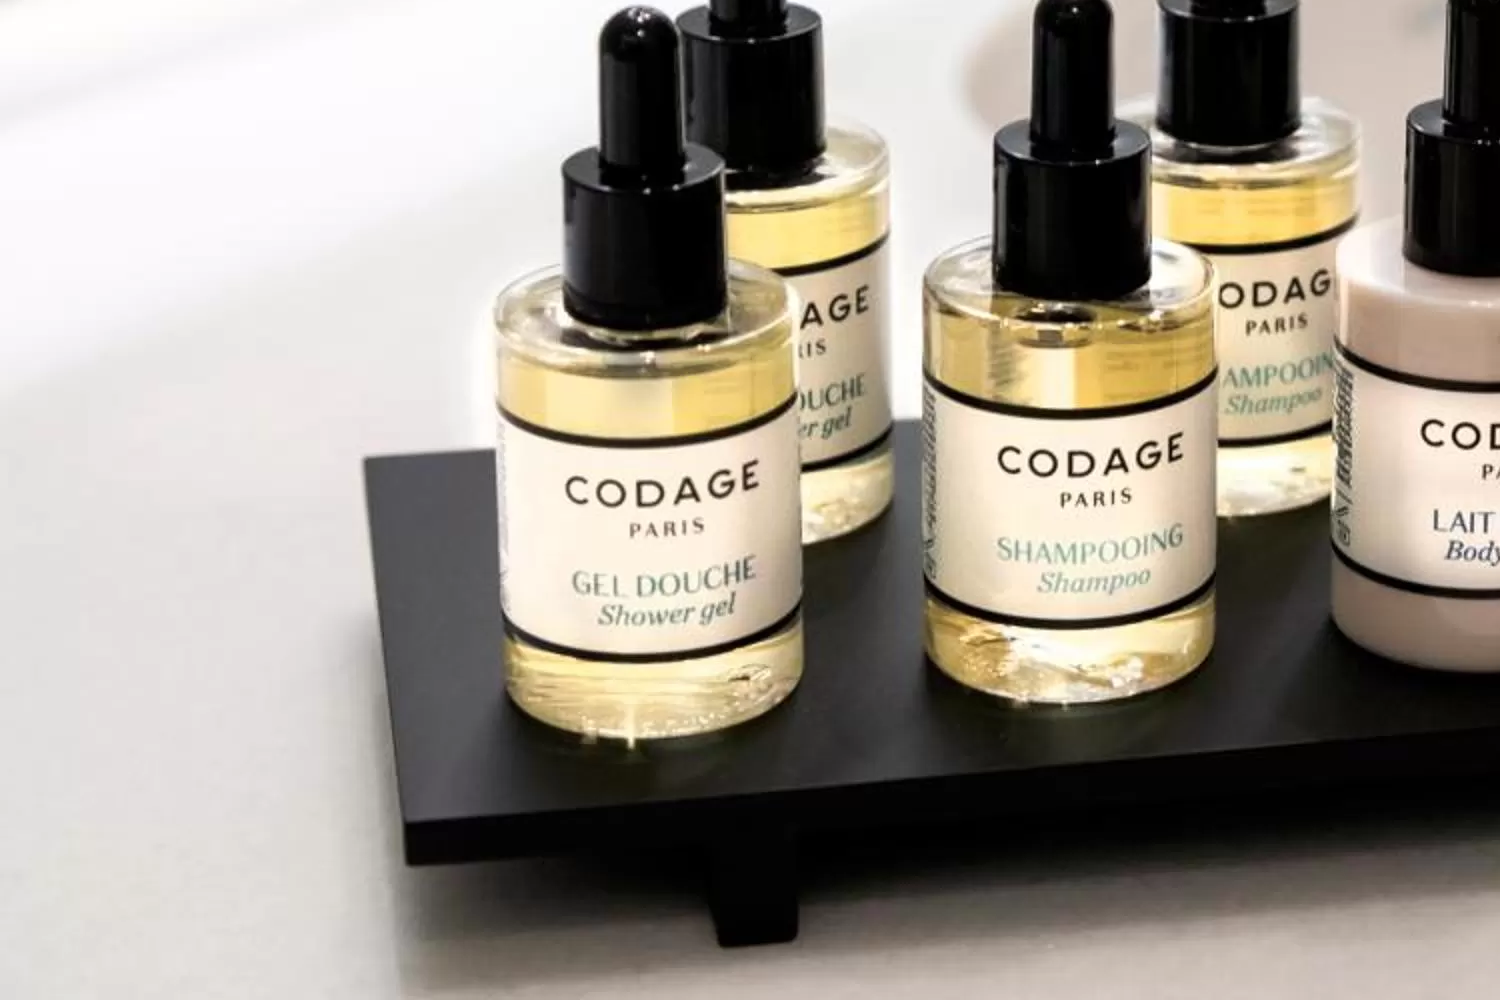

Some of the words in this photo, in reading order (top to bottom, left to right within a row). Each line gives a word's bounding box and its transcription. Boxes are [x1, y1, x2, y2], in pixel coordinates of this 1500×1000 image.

[1219, 268, 1331, 309] ODAG
[800, 284, 869, 330] AGE
[1246, 312, 1308, 336] PARIS
[1222, 351, 1333, 388] AMPOOIN
[800, 373, 865, 411] UCHE
[1224, 388, 1323, 415] Shampoo
[822, 406, 852, 439] gel
[997, 432, 1184, 478] CODAGE
[564, 459, 760, 508] CODAGE
[1060, 487, 1133, 508] PARIS
[629, 518, 705, 538] PARIS
[1433, 509, 1495, 534] LAIT
[996, 523, 1183, 564] SHAMPOOING
[571, 570, 627, 598] GEL
[636, 555, 756, 598] DOUCHE
[1036, 569, 1151, 596] Shampoo
[598, 599, 696, 627] Shower
[700, 592, 736, 623] gel
